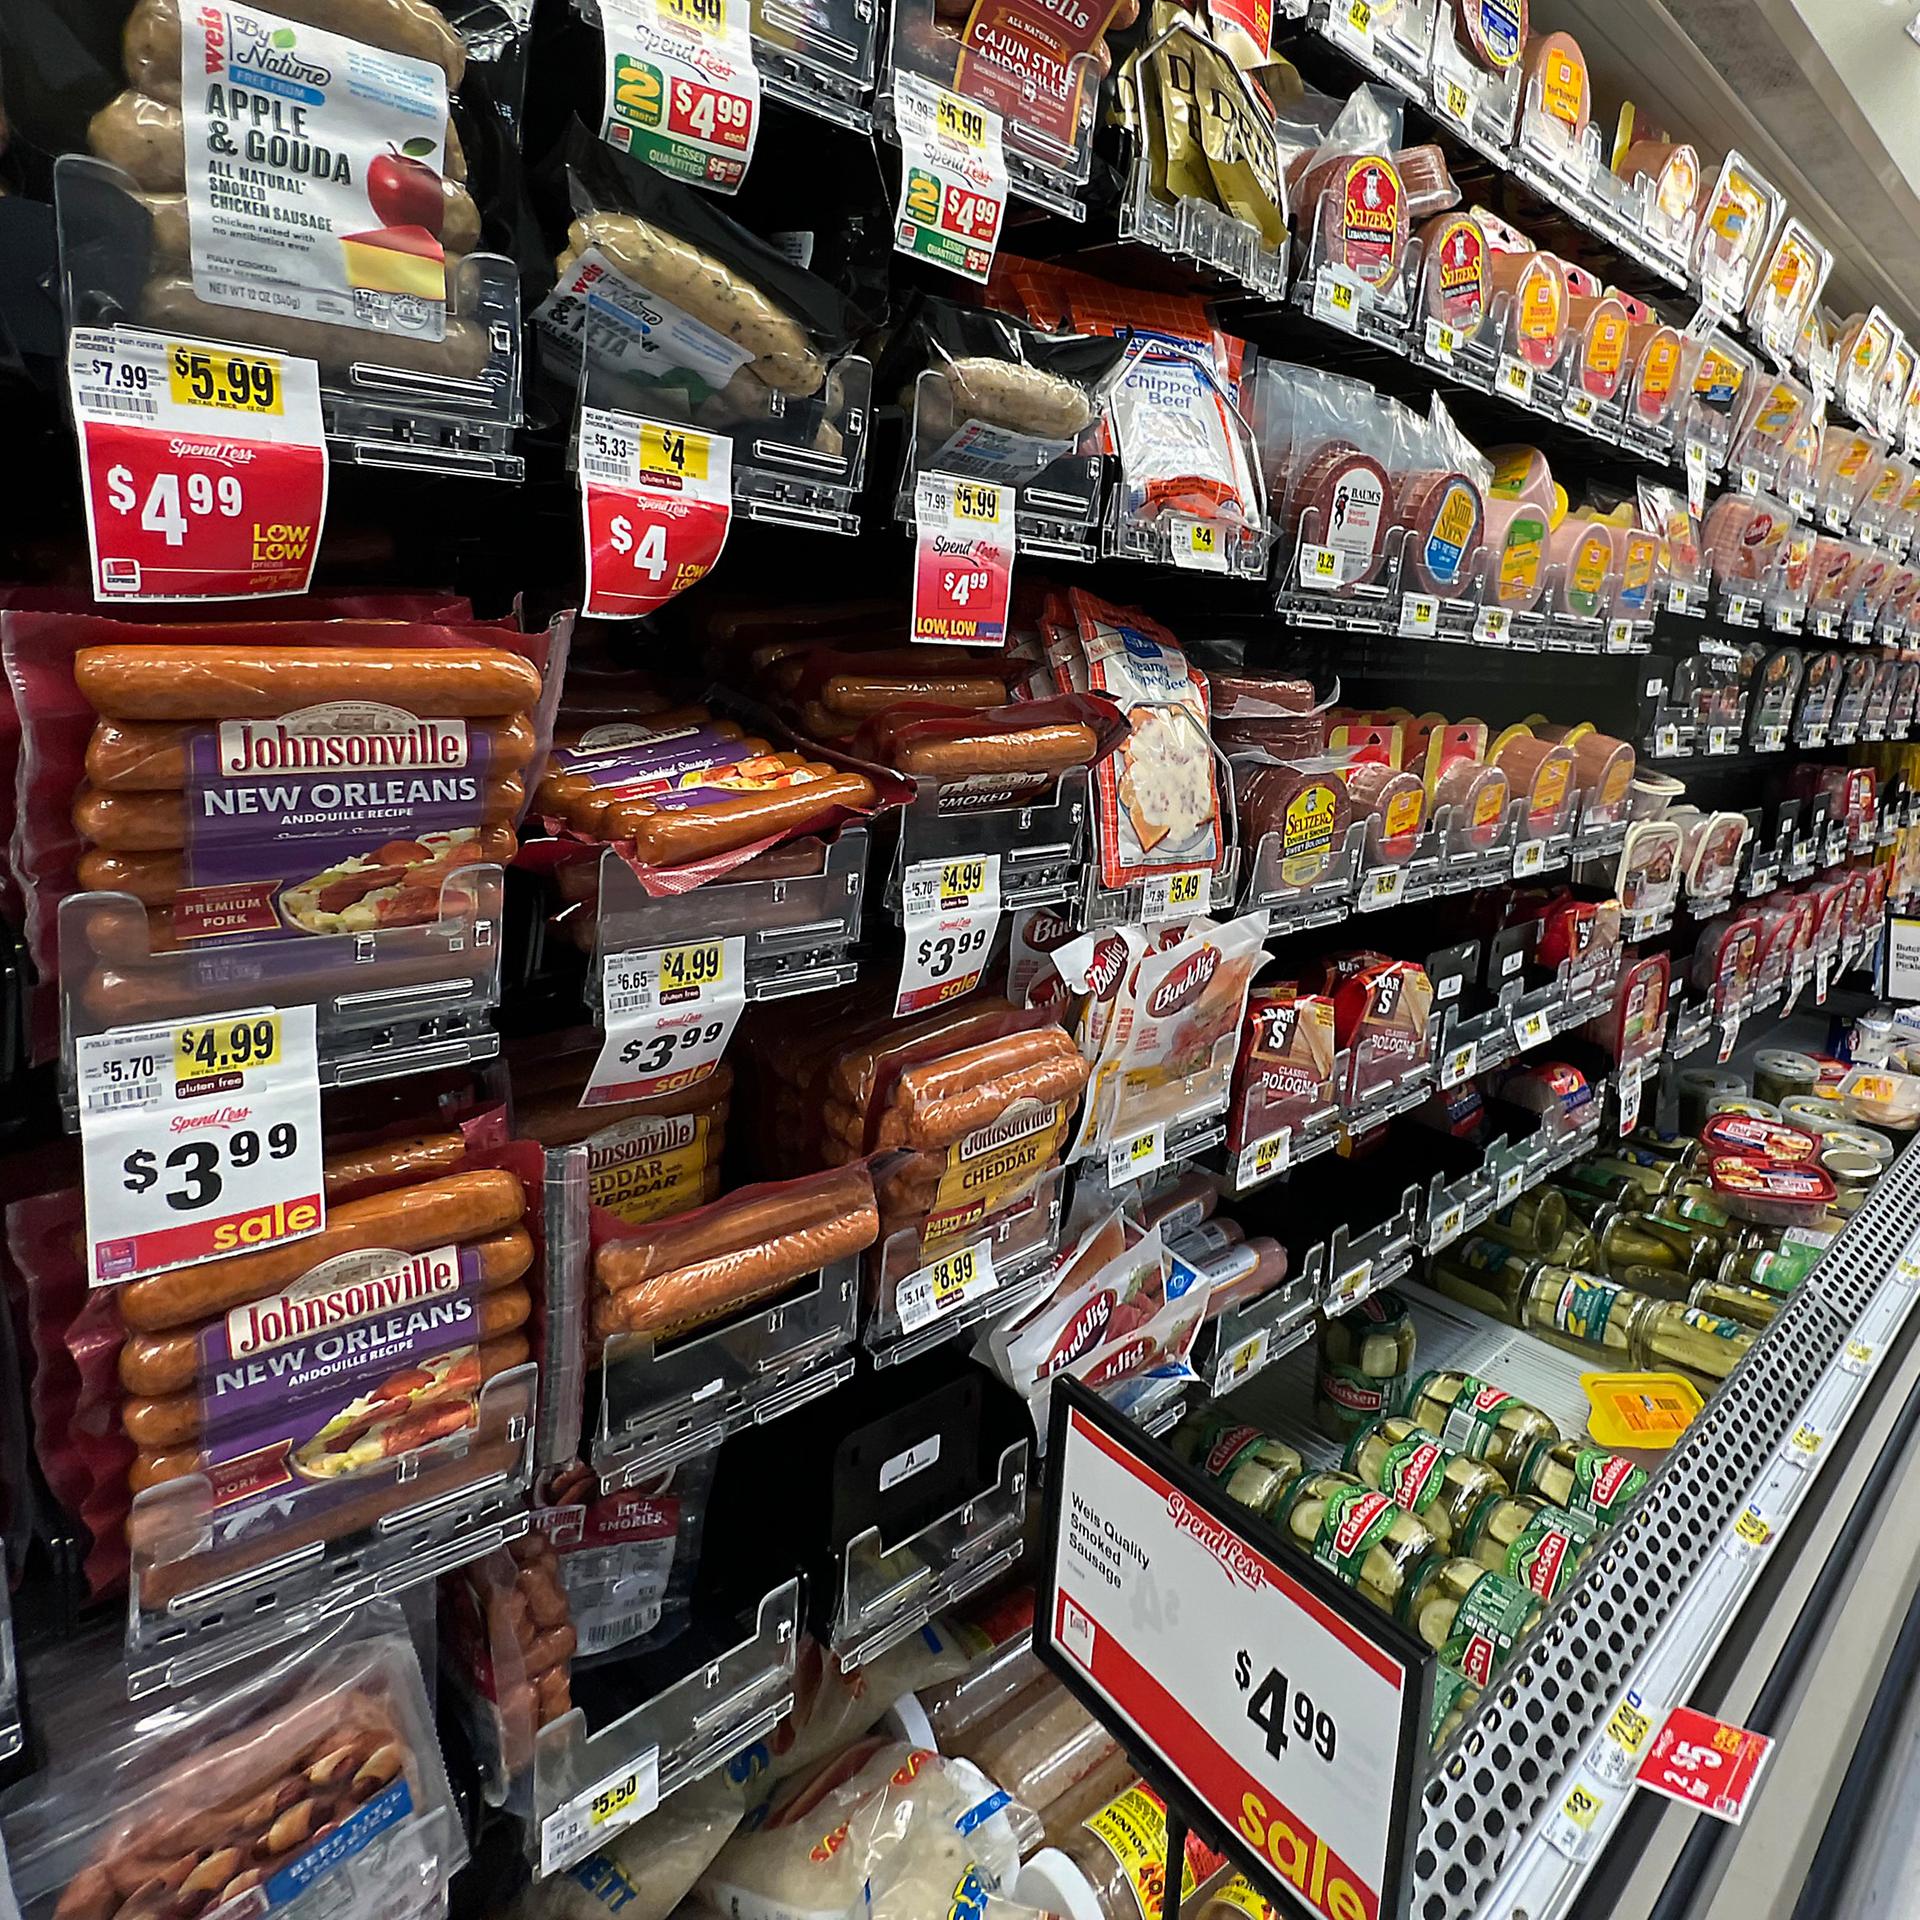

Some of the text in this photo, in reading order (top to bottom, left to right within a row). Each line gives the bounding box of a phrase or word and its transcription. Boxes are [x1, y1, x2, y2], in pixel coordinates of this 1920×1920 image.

[234, 15, 272, 47] By
[1007, 15, 1022, 28] ALL
[198, 7, 225, 75] weis
[634, 24, 736, 80] Spend Less
[237, 46, 332, 86] Nature
[630, 57, 648, 72] buy
[975, 23, 1076, 88] CAJUN STYLE
[977, 45, 1067, 100] ANDOUILLE
[617, 67, 660, 113] 2
[205, 83, 309, 139] APPLE
[616, 104, 627, 116] or
[940, 96, 982, 144] $5.99
[724, 132, 745, 144] each
[207, 120, 353, 186] & GOUDA
[649, 149, 703, 177] QUANTITIES
[671, 144, 706, 164] LESSER
[924, 143, 963, 173] Spend
[208, 160, 234, 178] ALL
[210, 178, 266, 201] SMOKED
[907, 178, 938, 217] 2
[211, 194, 333, 232] CHICKEN SAUSAGE
[1346, 200, 1396, 231] SELTZERS
[212, 215, 315, 243] Chicken raised with
[212, 226, 310, 252] no antibiotics ever
[927, 243, 963, 265] QUANTITIES
[942, 238, 966, 253] LESSER
[207, 254, 277, 273] FULLY COOKED
[1441, 256, 1481, 288] SELTZERS
[571, 263, 603, 294] weis
[209, 283, 300, 310] NET WT 12 OZ (340g)
[606, 288, 662, 325] Nature
[93, 347, 274, 407] $7.99 $5.99
[1126, 374, 1201, 397] Chipped
[1149, 392, 1192, 409] Beef
[169, 439, 255, 463] Spend Less
[595, 430, 685, 470] $5.33 $4
[637, 496, 666, 510] Spend
[924, 484, 997, 518] $7.99 $5.99
[1451, 494, 1470, 522] Slim
[611, 515, 667, 580] $4
[933, 536, 973, 556] Spend
[1196, 528, 1211, 545] $4
[252, 543, 307, 561] LOW
[951, 620, 976, 636] LOW
[231, 723, 459, 771] Johnsonville
[678, 757, 714, 772] Sausage
[204, 777, 477, 816] NEW ORLEANS
[939, 791, 1011, 808] SMOKED
[281, 807, 414, 825] ANDOUILLE RECIPE
[1285, 802, 1334, 837] SELTZERS
[1285, 844, 1305, 857] SWEET
[1286, 832, 1307, 846] DOUBLE
[912, 861, 982, 897] $5.70 $4.99
[1172, 874, 1198, 900] $5.49
[185, 898, 261, 915] PREMIUM
[203, 914, 247, 928] PORK
[618, 970, 647, 990] $6.65
[664, 948, 719, 982] $4.99
[1091, 938, 1129, 997] Buddig
[1154, 946, 1216, 1012] Buddig
[661, 989, 699, 1003] gluten free
[939, 973, 976, 1001] sale
[1376, 976, 1400, 991] BAR
[1377, 990, 1393, 1014] S
[1269, 1021, 1287, 1049] S
[1372, 1034, 1415, 1053] BOLOGNA
[1385, 1028, 1409, 1039] CLASSIC
[103, 1020, 273, 1082] $5.70 $4.99
[652, 1063, 712, 1094] sale
[1262, 1072, 1318, 1097] BOLOGNA
[1279, 1065, 1309, 1079] CLASSIC
[178, 1077, 242, 1097] gluten free
[170, 1107, 252, 1133] Spend Less
[963, 1107, 1052, 1157] Johnsonville
[962, 1148, 1036, 1190] CHEDDAR
[213, 1203, 317, 1250] sale
[927, 1214, 961, 1232] PARTY
[905, 1286, 926, 1305] $5.14
[934, 1252, 973, 1290] $8.99
[240, 1258, 452, 1352] Johnsonville
[215, 1297, 473, 1396] NEW ORLEANS
[288, 1338, 414, 1387] ANDOUILLE RECIPE
[905, 1450, 915, 1468] A
[216, 1475, 259, 1497] PORK
[600, 1511, 663, 1532] SMOKIES
[1072, 1491, 1101, 1528] Weis
[1104, 1521, 1150, 1570] Quality
[1339, 1492, 1390, 1549] claussen
[1071, 1513, 1121, 1566] Smoked
[1165, 1491, 1268, 1589] Spend Less
[1069, 1532, 1122, 1588] Sausage
[1664, 1770, 1691, 1788] 2
[1238, 1792, 1367, 1920] sale
